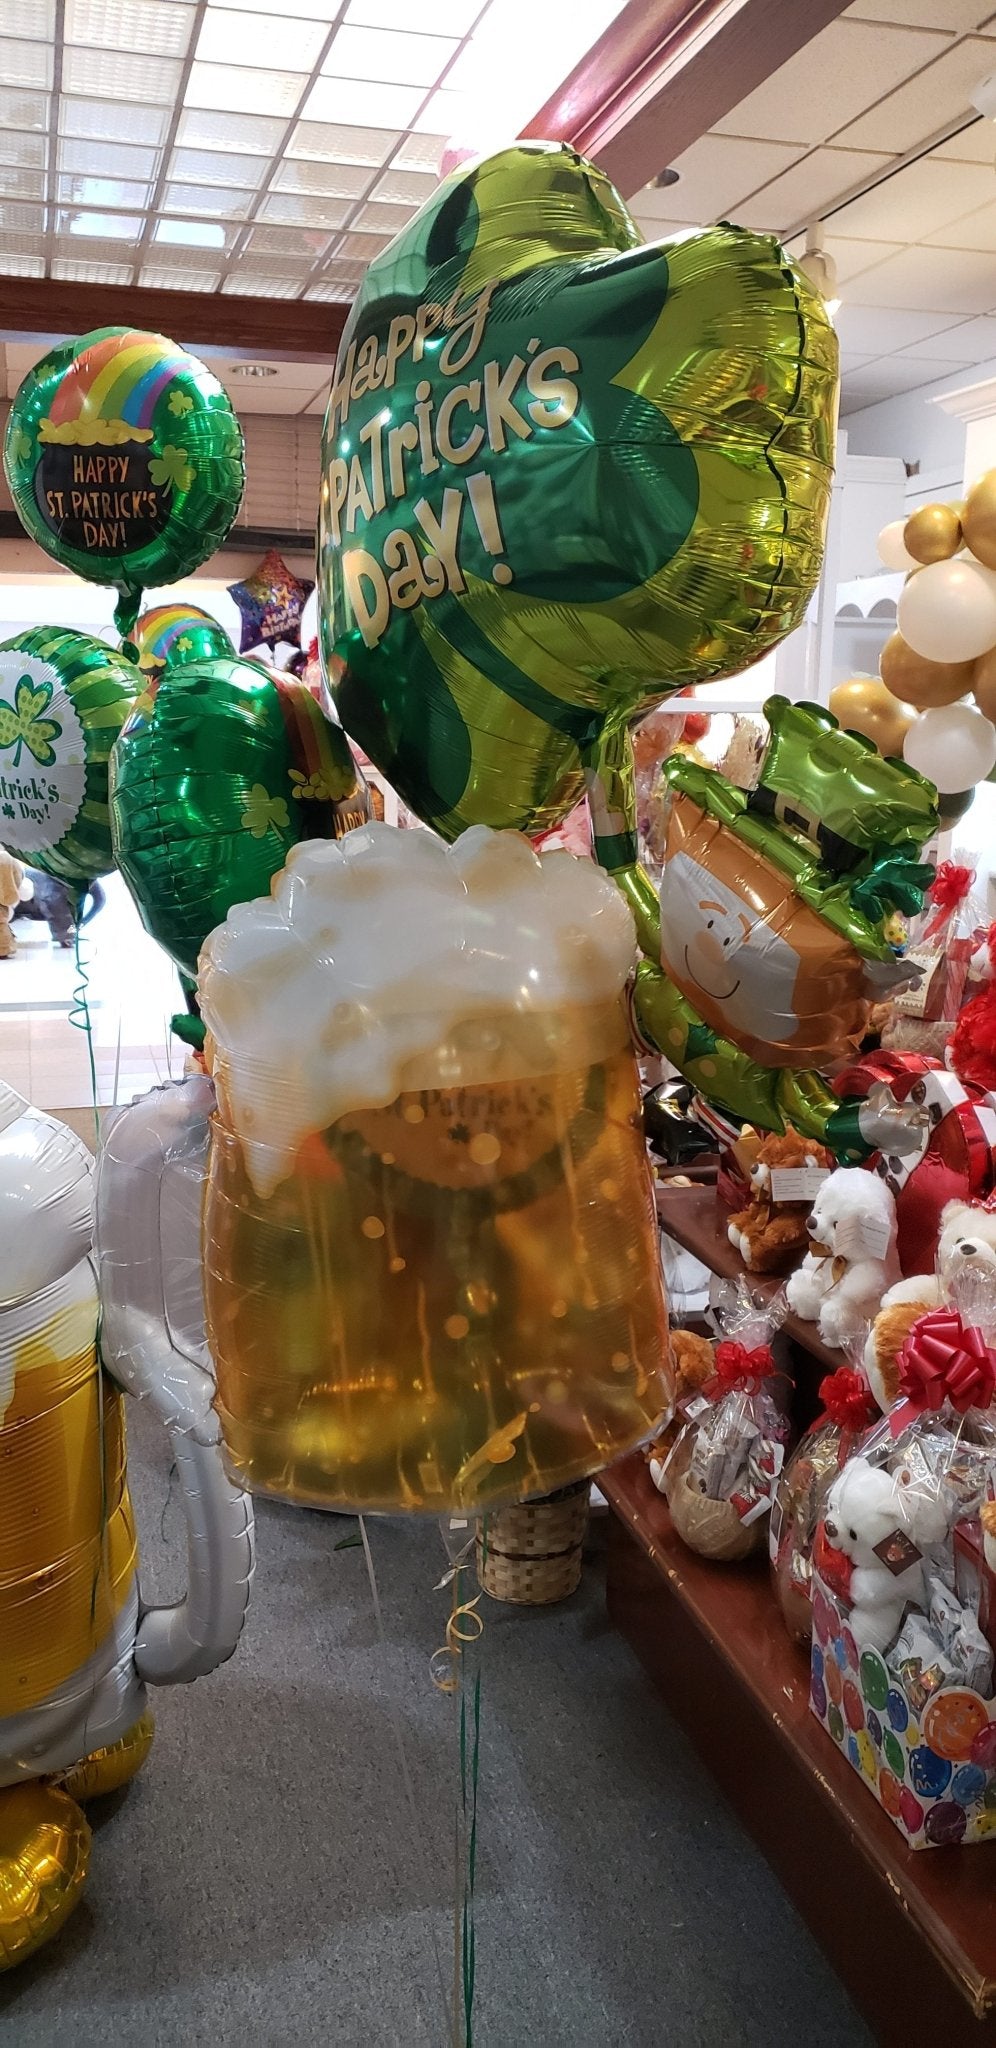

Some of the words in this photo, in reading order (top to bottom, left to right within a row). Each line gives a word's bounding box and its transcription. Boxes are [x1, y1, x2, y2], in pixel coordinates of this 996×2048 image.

[73, 455, 130, 483] HAPPY
[46, 490, 69, 519] ST.
[71, 490, 158, 519] PATRICK'S
[83, 521, 128, 548] DAY!
[0, 776, 60, 803] trick's
[17, 802, 51, 825] Day!
